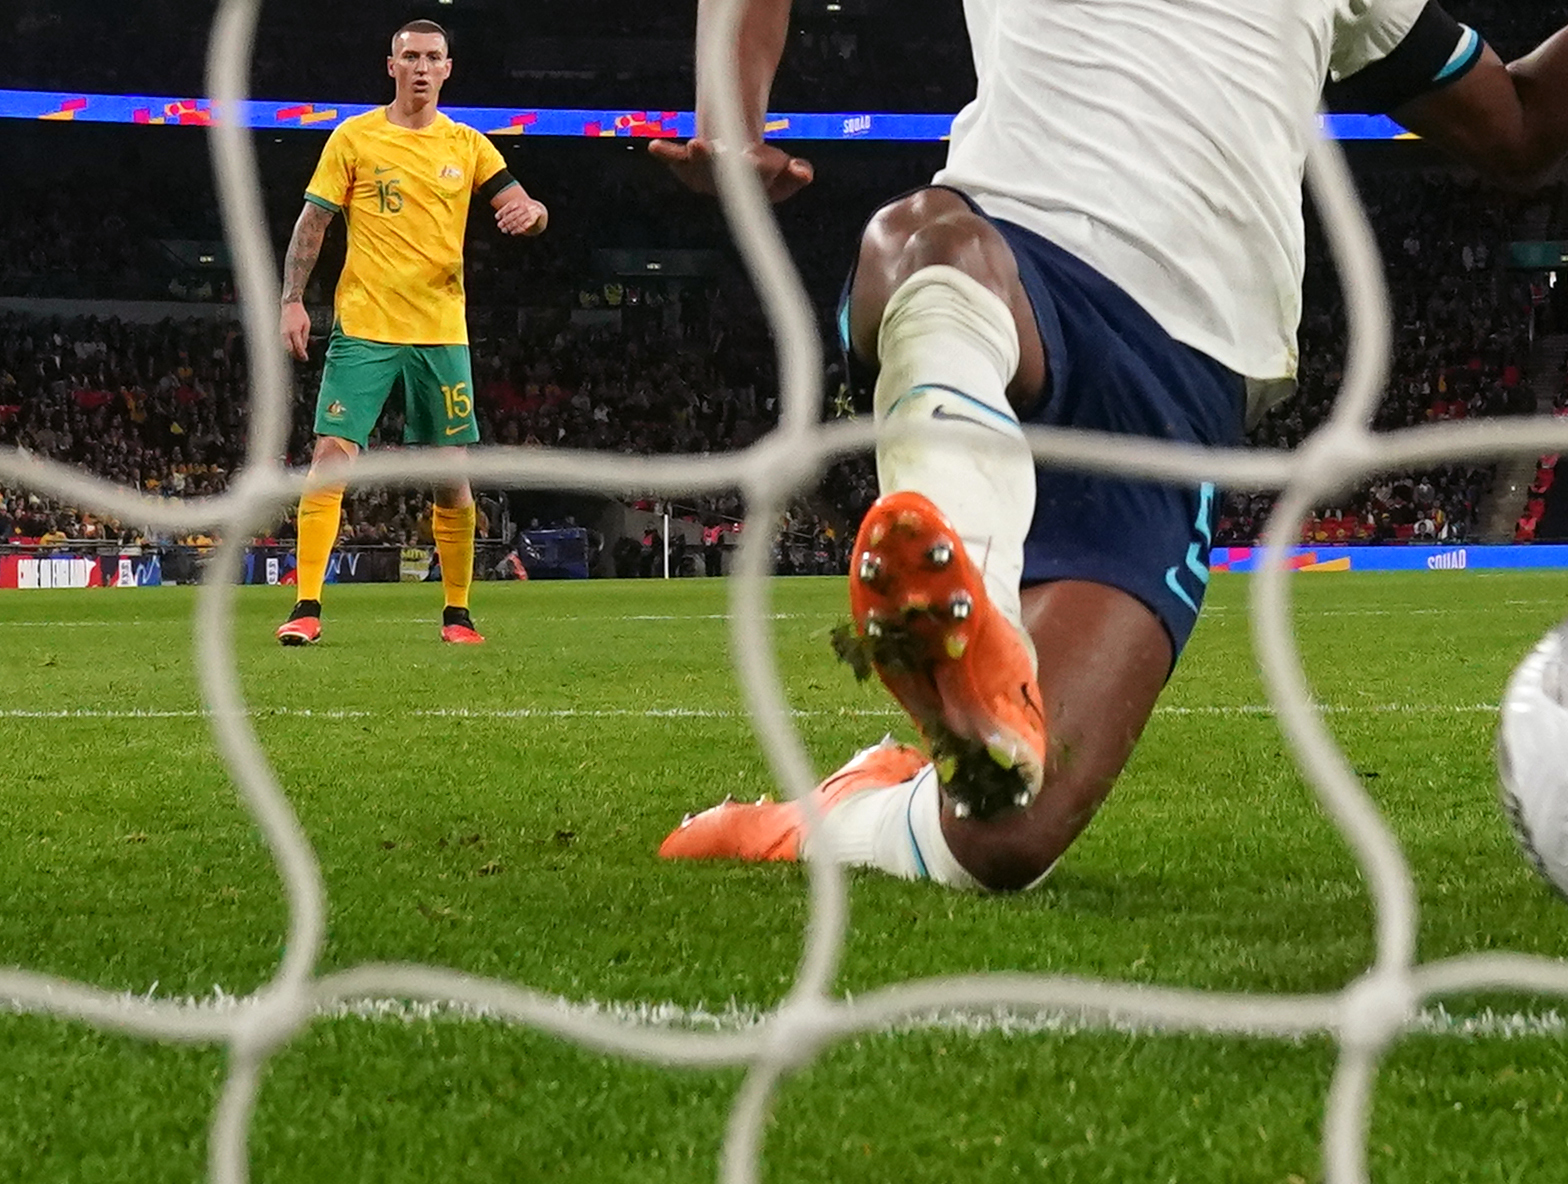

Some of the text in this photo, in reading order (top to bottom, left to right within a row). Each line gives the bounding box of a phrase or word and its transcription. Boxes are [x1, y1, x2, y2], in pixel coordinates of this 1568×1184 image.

[843, 114, 871, 134] SQUAD
[375, 179, 404, 214] 15
[441, 381, 471, 420] 15
